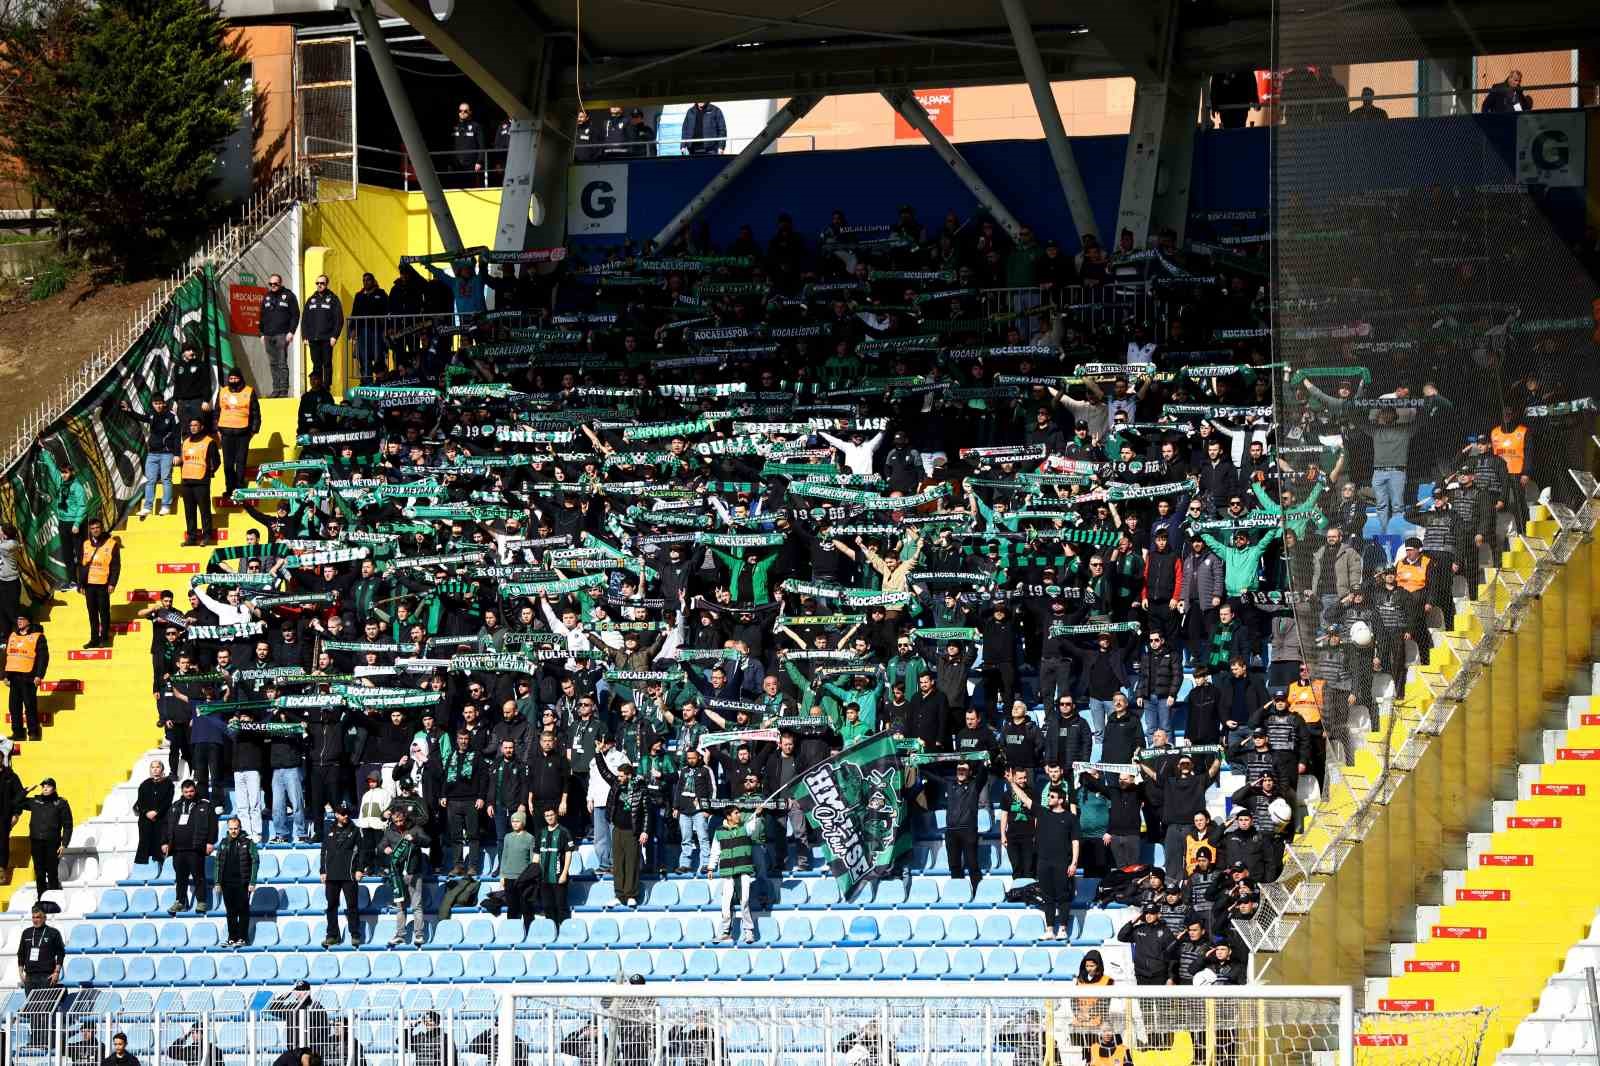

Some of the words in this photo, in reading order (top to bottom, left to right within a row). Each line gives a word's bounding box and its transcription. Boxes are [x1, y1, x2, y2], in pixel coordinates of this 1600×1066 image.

[1532, 130, 1569, 169] G
[581, 181, 616, 218] G
[714, 535, 767, 545] KOCAELISPOR
[616, 671, 668, 681] KOCAELISPOR
[287, 695, 342, 708] KOCAELISPOR
